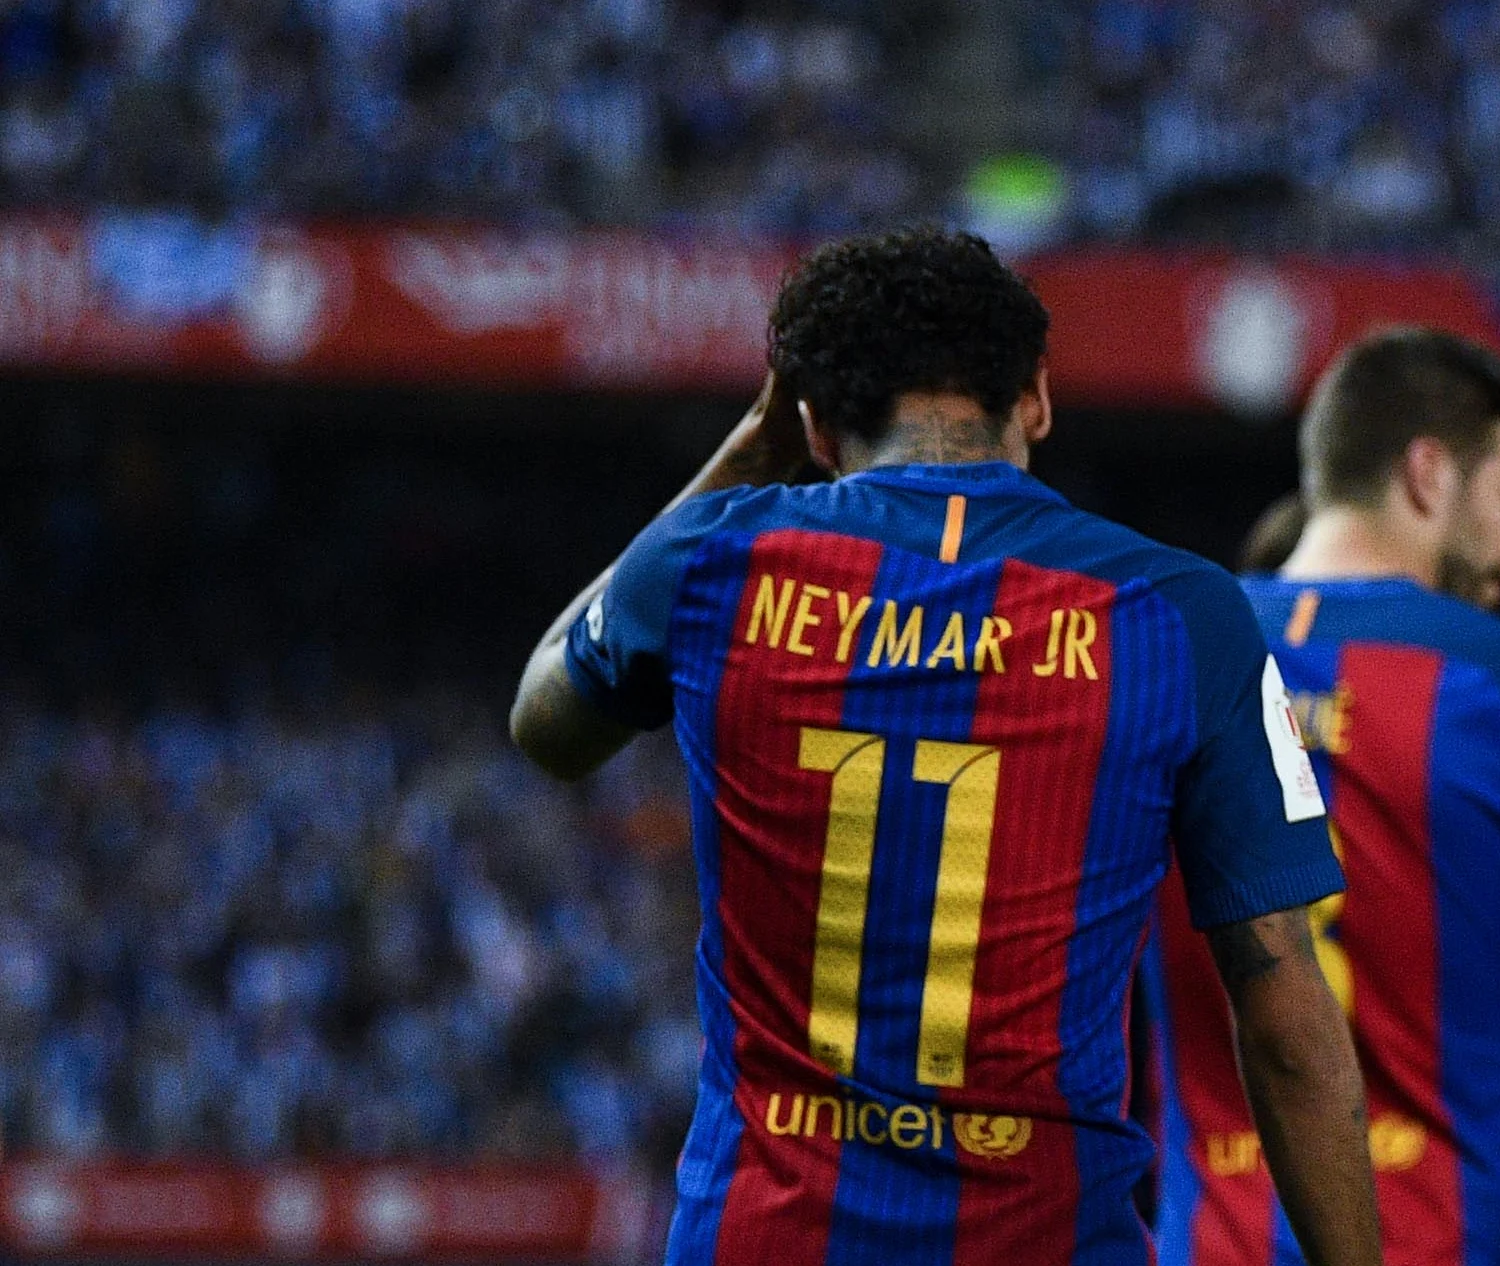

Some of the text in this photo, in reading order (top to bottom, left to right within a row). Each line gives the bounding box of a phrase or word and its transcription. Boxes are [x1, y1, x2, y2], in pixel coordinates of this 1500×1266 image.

[745, 573, 1099, 681] NEYMAR JR
[797, 726, 1001, 1089] 11
[765, 1089, 947, 1150] unicef
